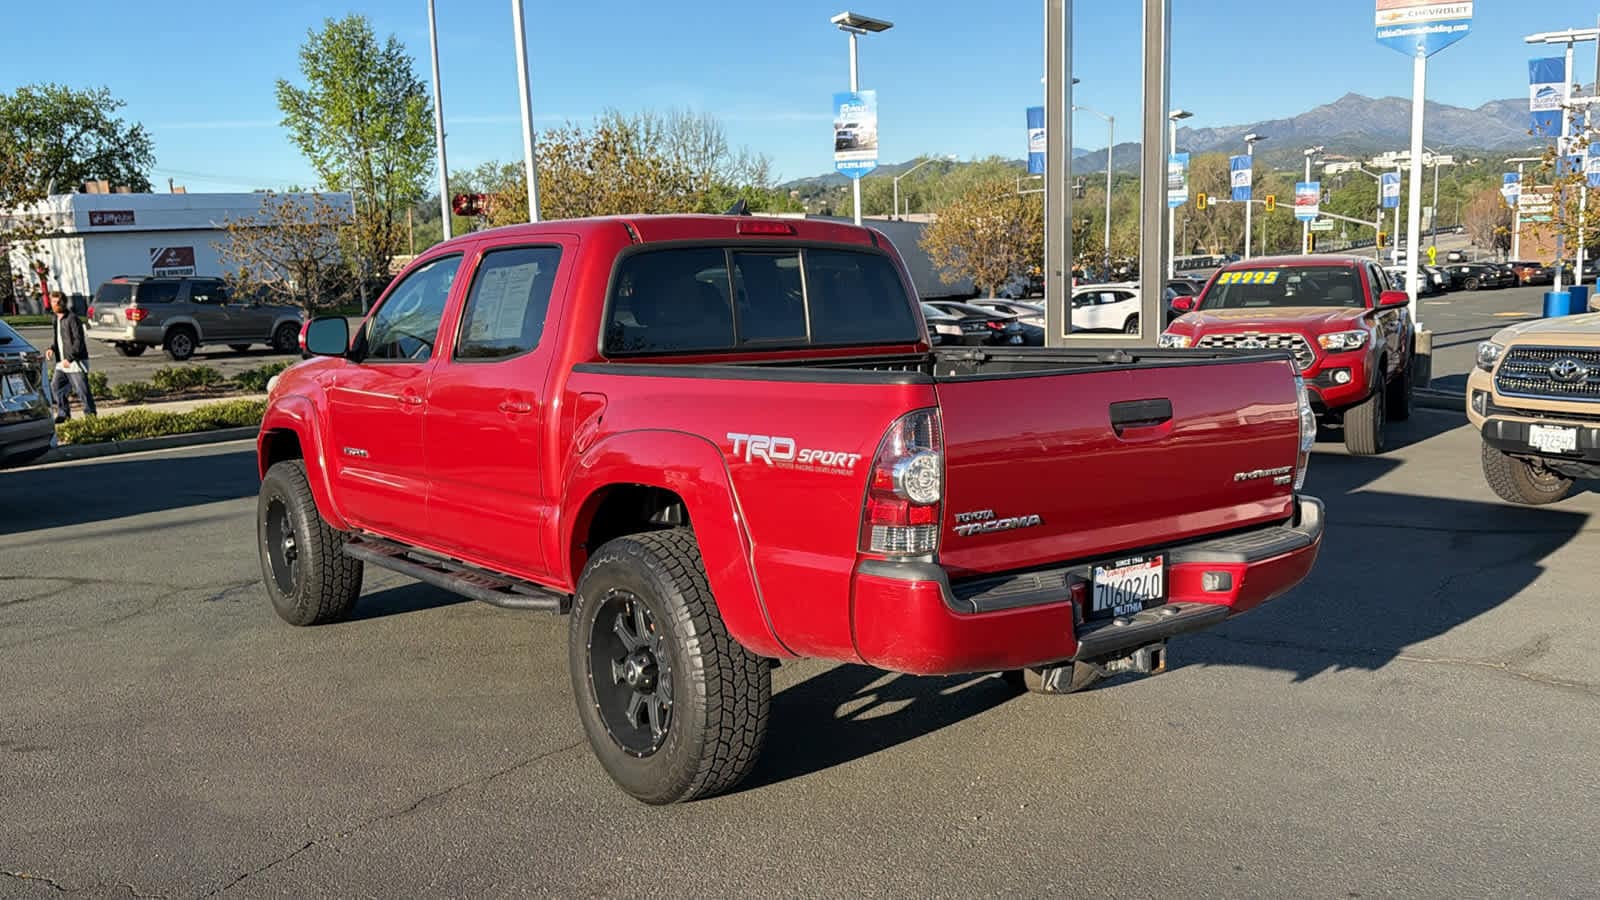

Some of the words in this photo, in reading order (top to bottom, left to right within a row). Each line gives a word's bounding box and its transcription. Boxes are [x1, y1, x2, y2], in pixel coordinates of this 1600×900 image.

[1408, 6, 1468, 17] CHEVROLET
[726, 432, 796, 465] TRD
[797, 448, 861, 467] SPORT
[954, 510, 994, 522] TOYOTA
[952, 514, 1042, 537] TACOMA
[1096, 573, 1159, 609] 7U60240
[1120, 601, 1143, 614] LITHIA
